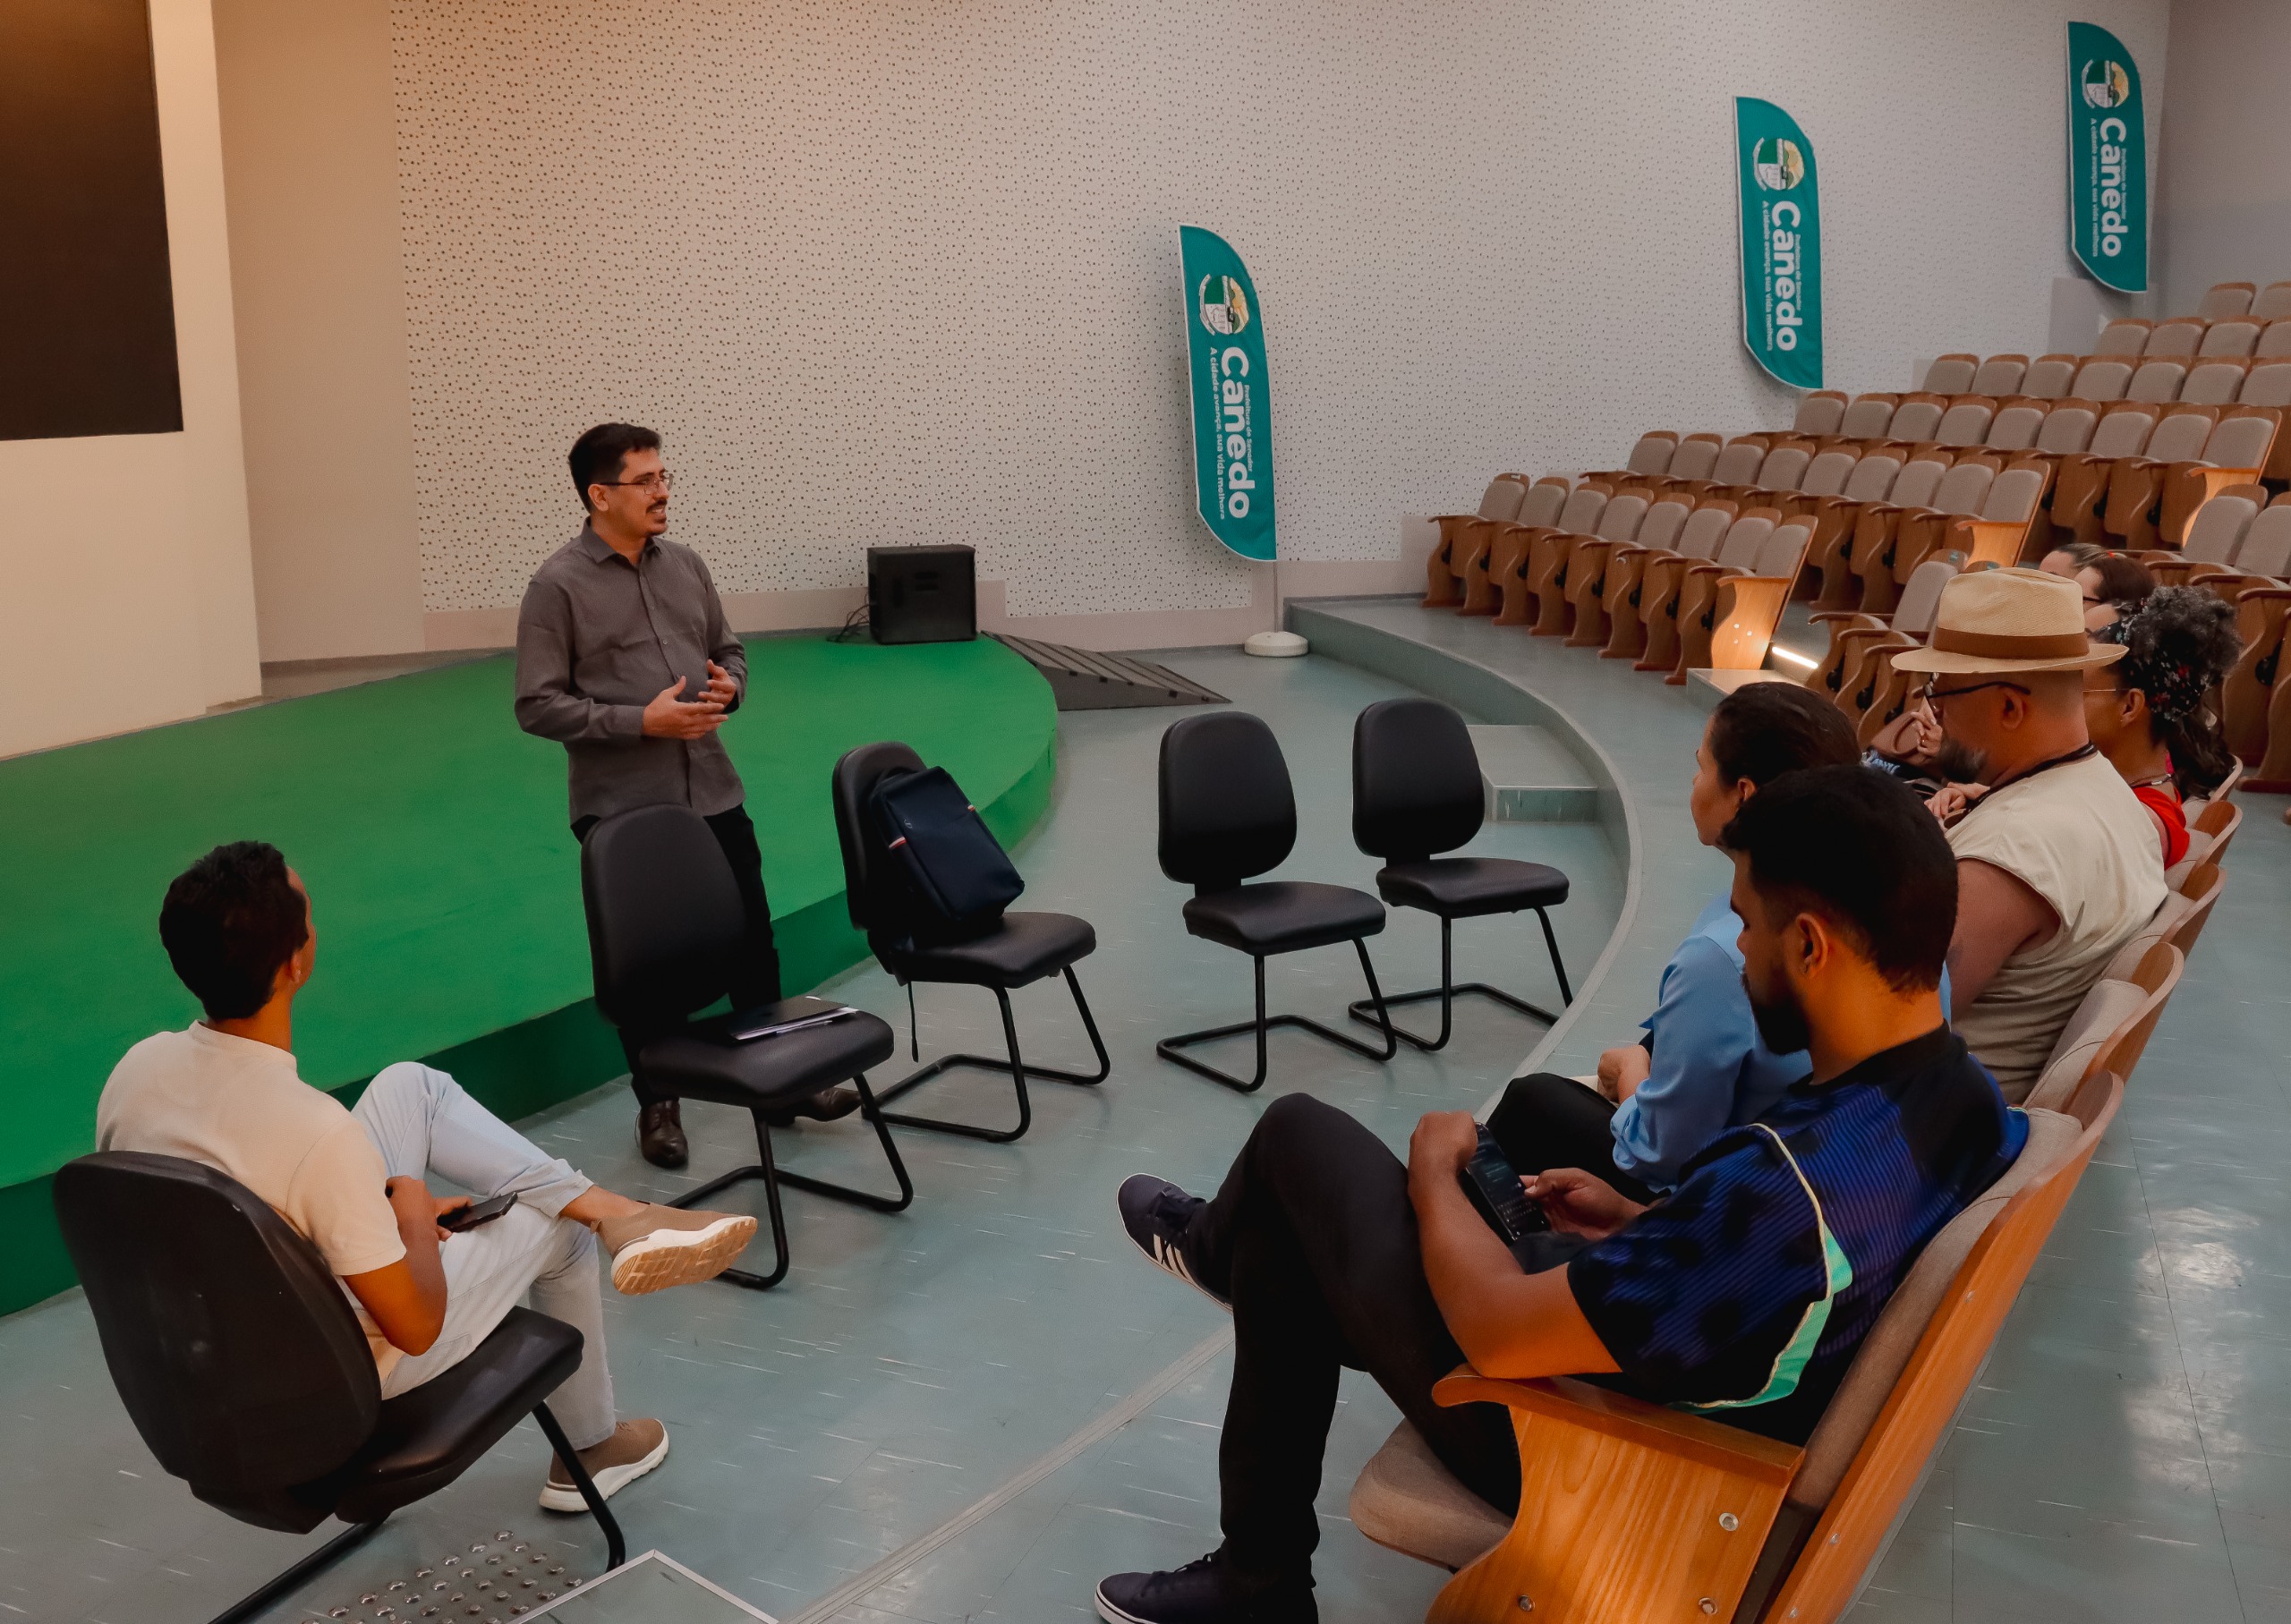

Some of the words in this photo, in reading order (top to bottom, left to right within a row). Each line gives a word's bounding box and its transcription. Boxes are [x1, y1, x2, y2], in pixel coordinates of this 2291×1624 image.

[2100, 117, 2128, 257] Canedo
[1771, 200, 1802, 351] Canedo
[1210, 347, 1217, 355] A
[1210, 357, 1219, 392] cidade
[1244, 385, 1252, 425] Prefeitura
[1221, 346, 1255, 518] Canedo
[1217, 454, 1225, 475] vida
[1217, 478, 1225, 519] melhora
